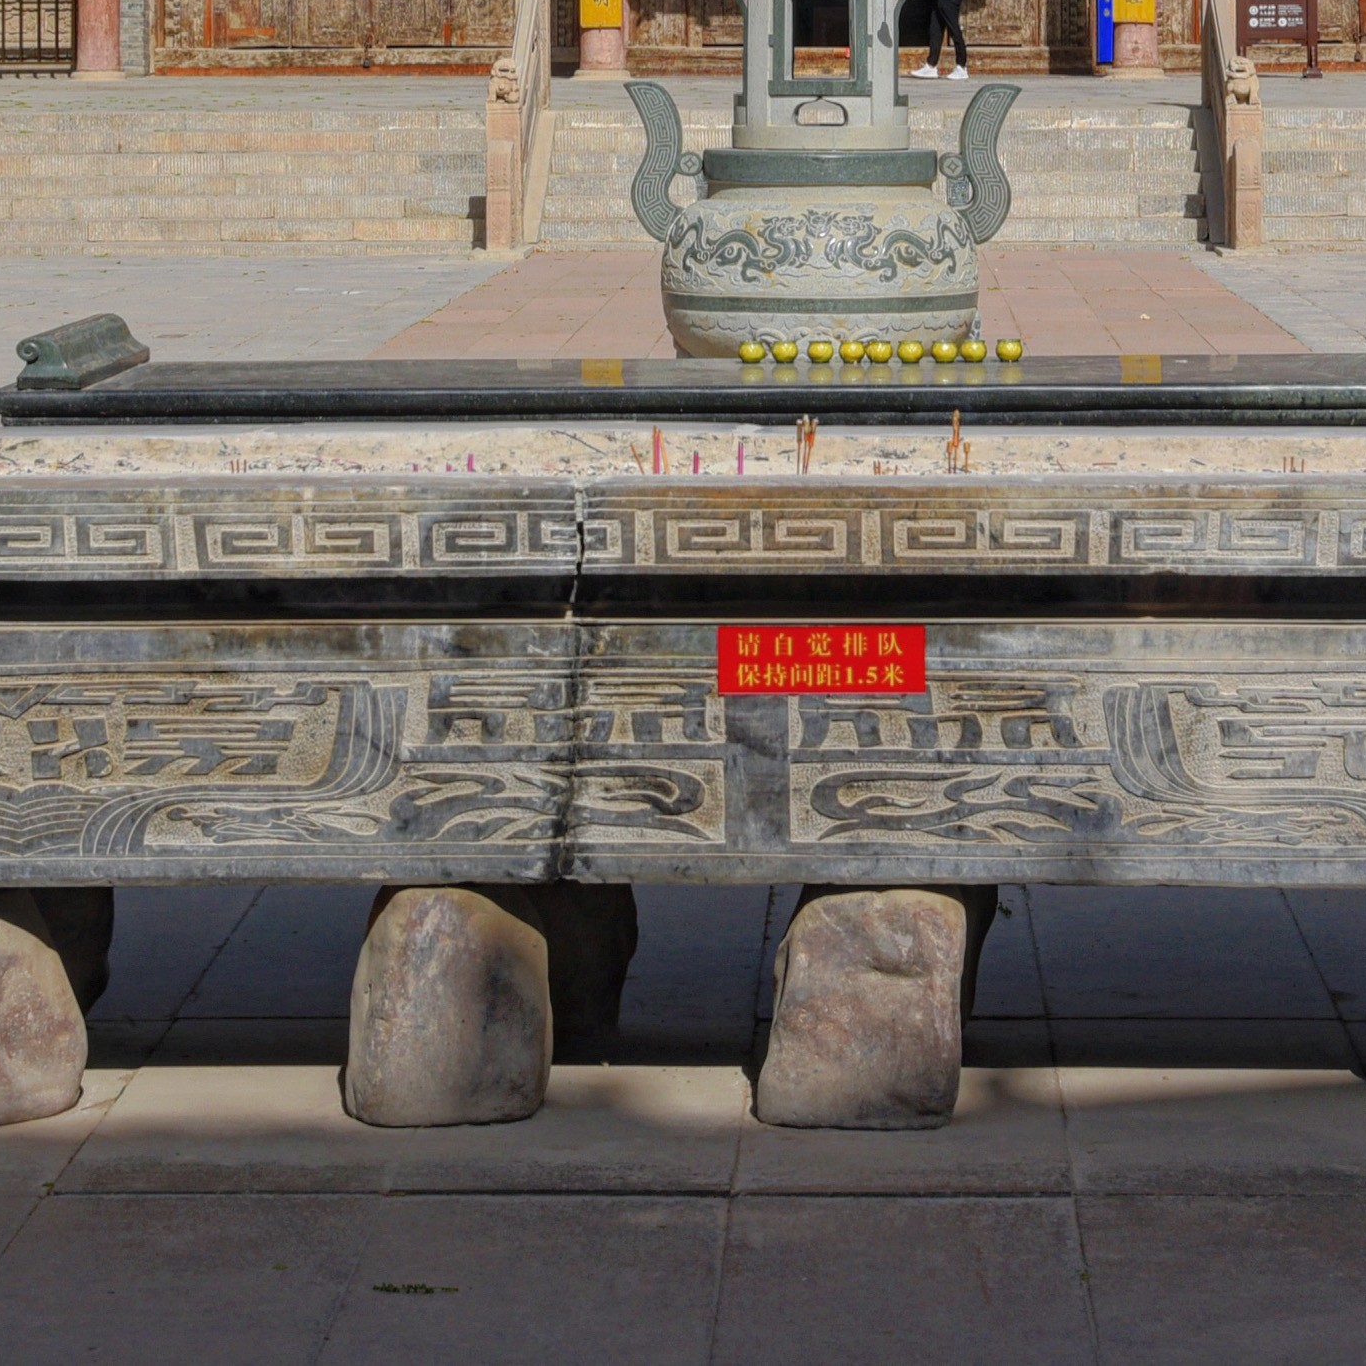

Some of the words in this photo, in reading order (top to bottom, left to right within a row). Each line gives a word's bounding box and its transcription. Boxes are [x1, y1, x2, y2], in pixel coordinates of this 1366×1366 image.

[736, 632, 903, 657] 请自觉排队
[736, 663, 904, 687] 保持间距1.5米
